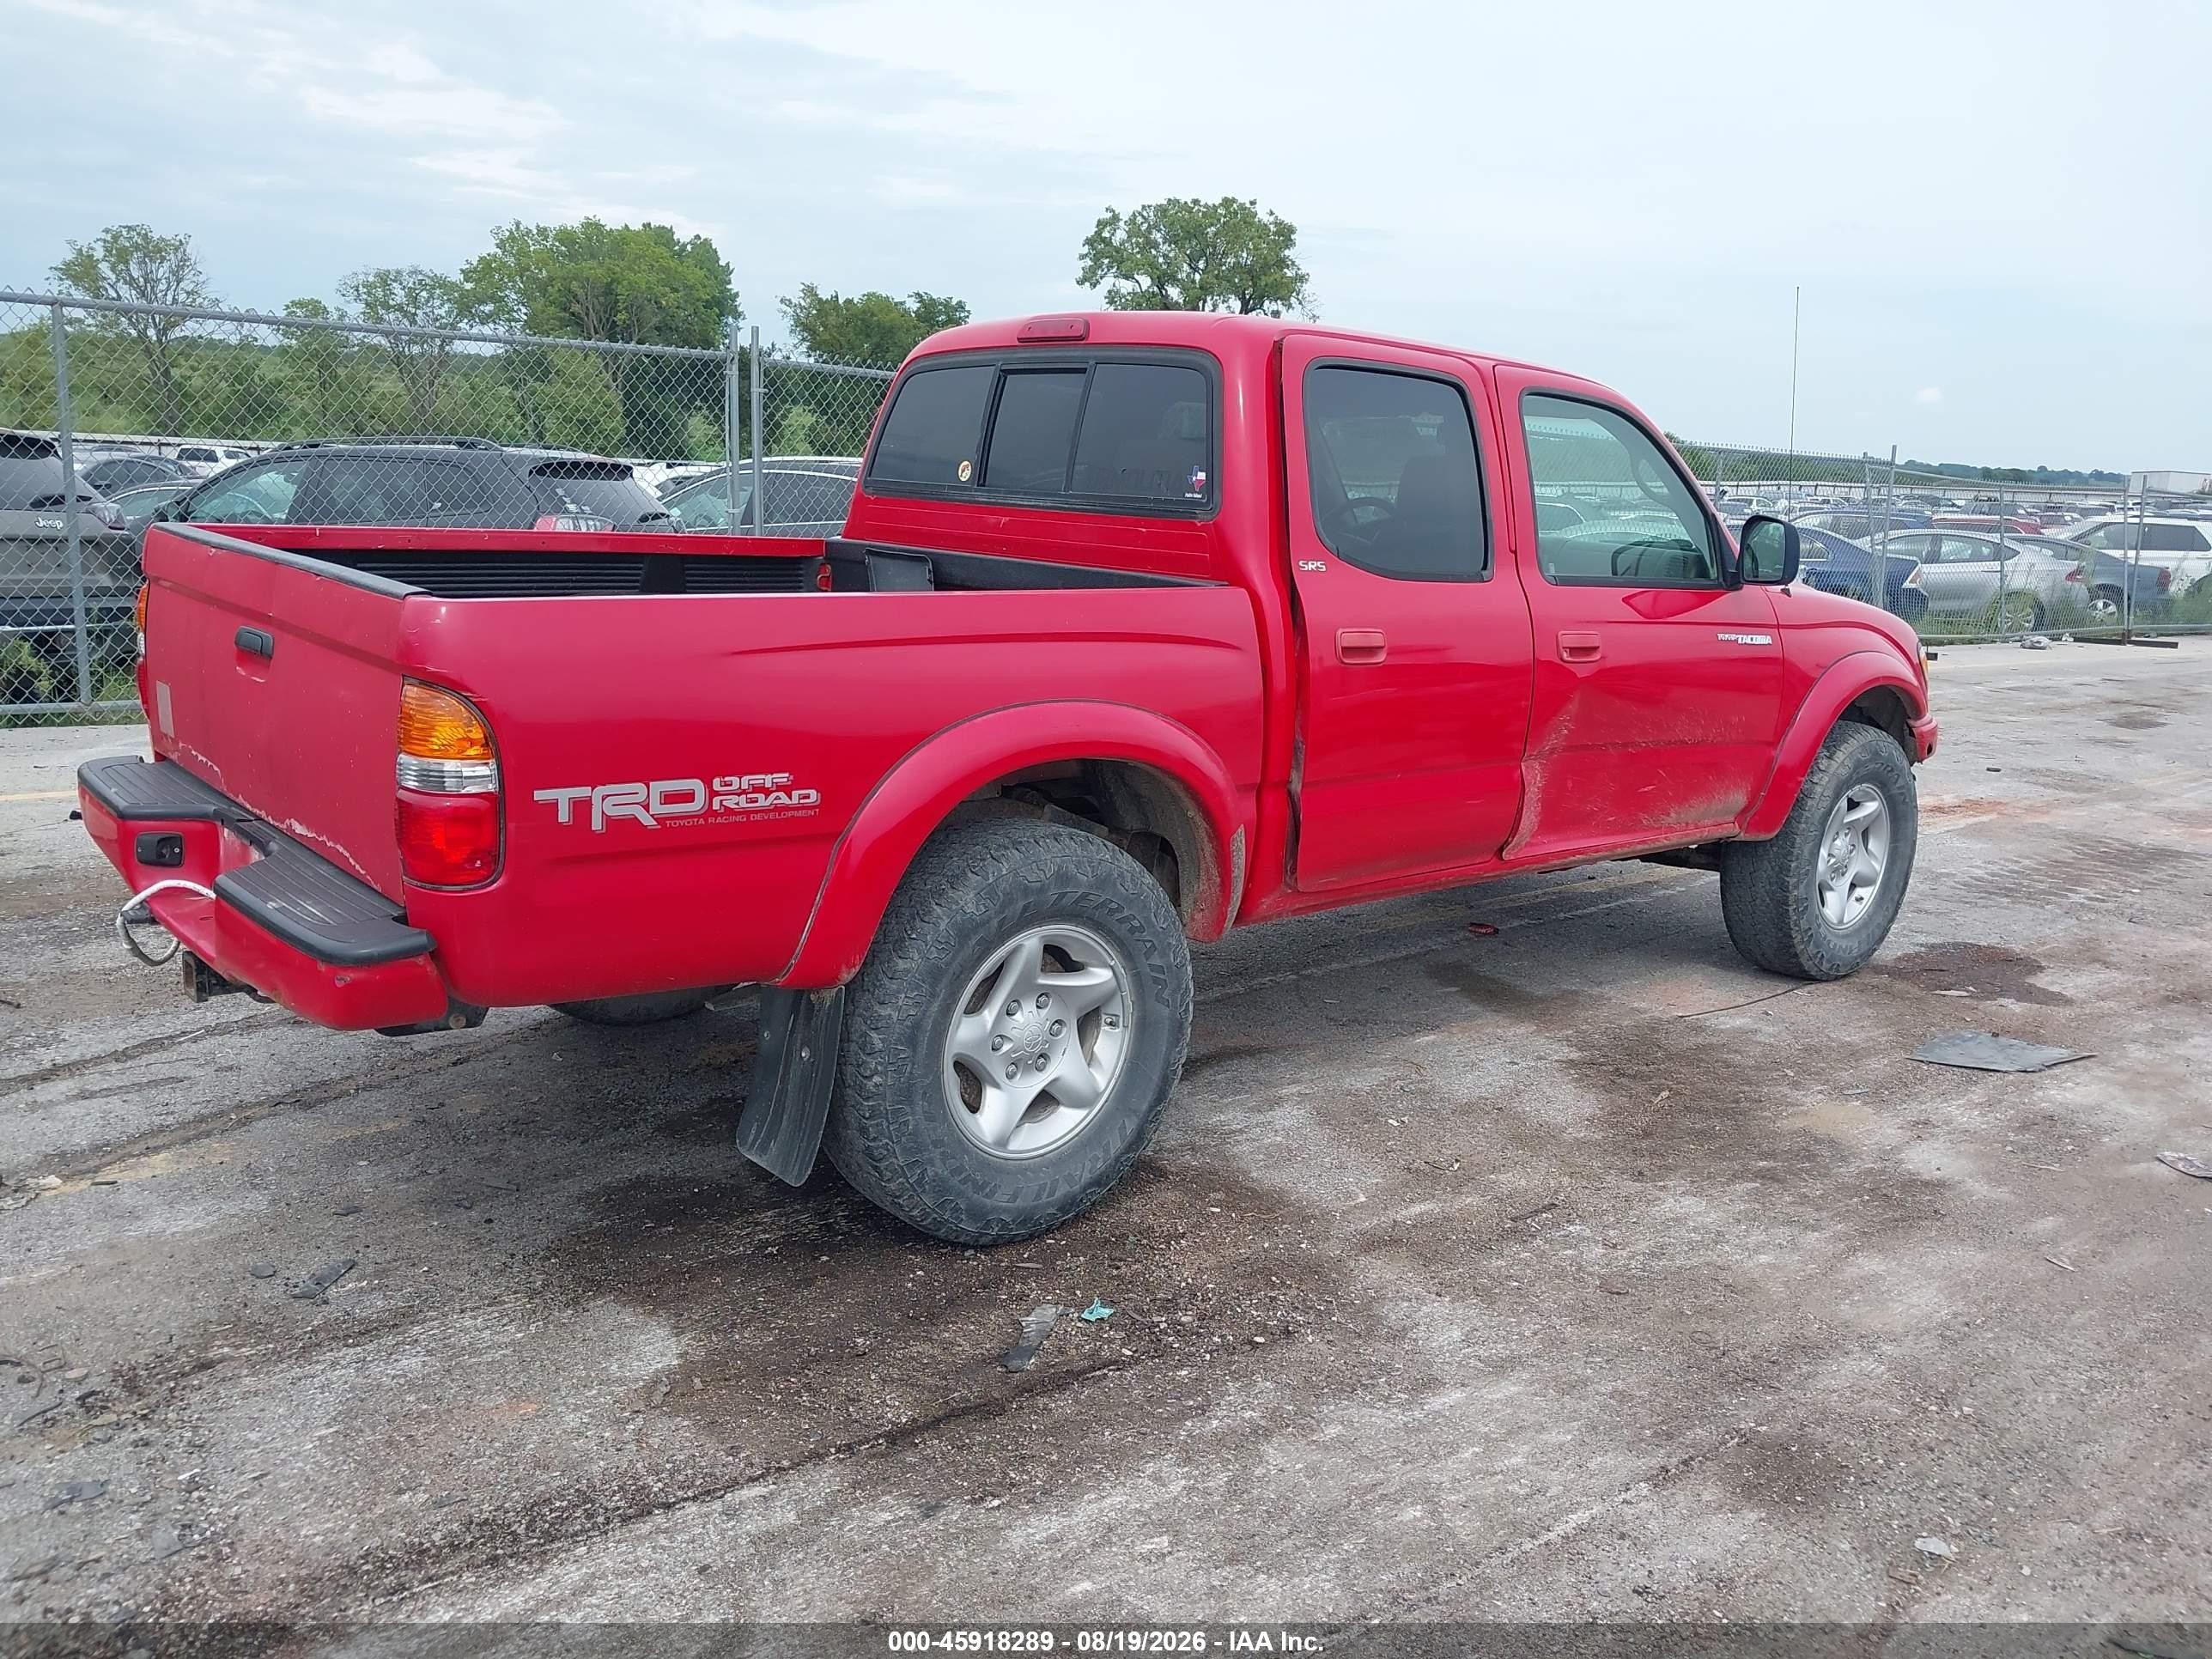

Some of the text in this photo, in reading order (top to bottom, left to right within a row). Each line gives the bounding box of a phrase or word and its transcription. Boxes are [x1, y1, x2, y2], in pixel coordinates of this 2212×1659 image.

[35, 516, 64, 530] Jeep
[712, 772, 793, 793] OFF
[533, 778, 708, 833] TRD
[712, 788, 821, 812] ROAD
[665, 808, 820, 829] TOYOTA RACING DEVELOPMENT
[1047, 890, 1170, 1010] TERRAIN
